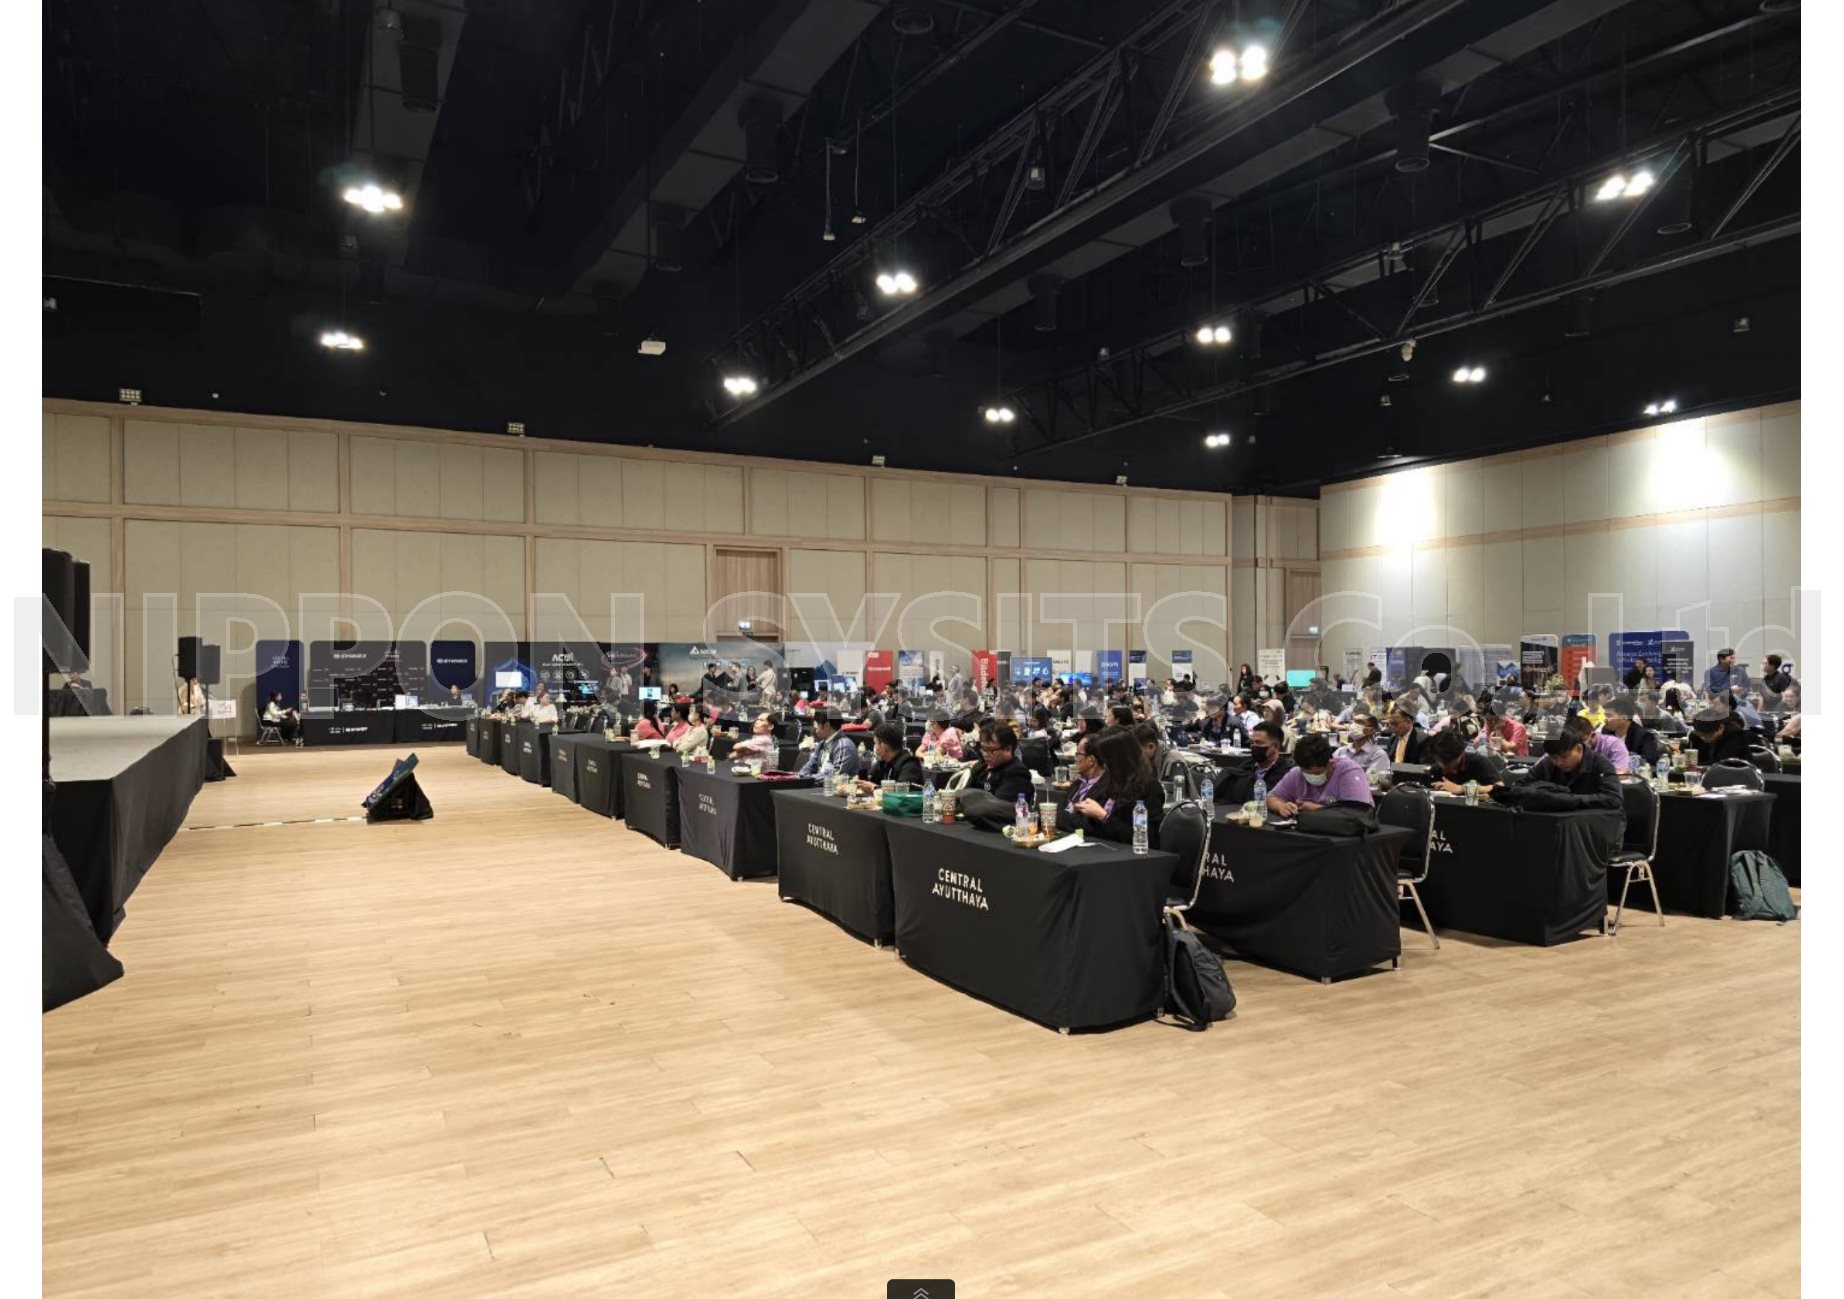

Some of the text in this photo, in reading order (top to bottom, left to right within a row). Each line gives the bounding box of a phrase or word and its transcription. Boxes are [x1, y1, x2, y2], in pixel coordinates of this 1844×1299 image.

[808, 823, 835, 841] CENTRAL
[938, 868, 983, 893] CENTRAL
[932, 882, 989, 911] AYUTTHAYA
